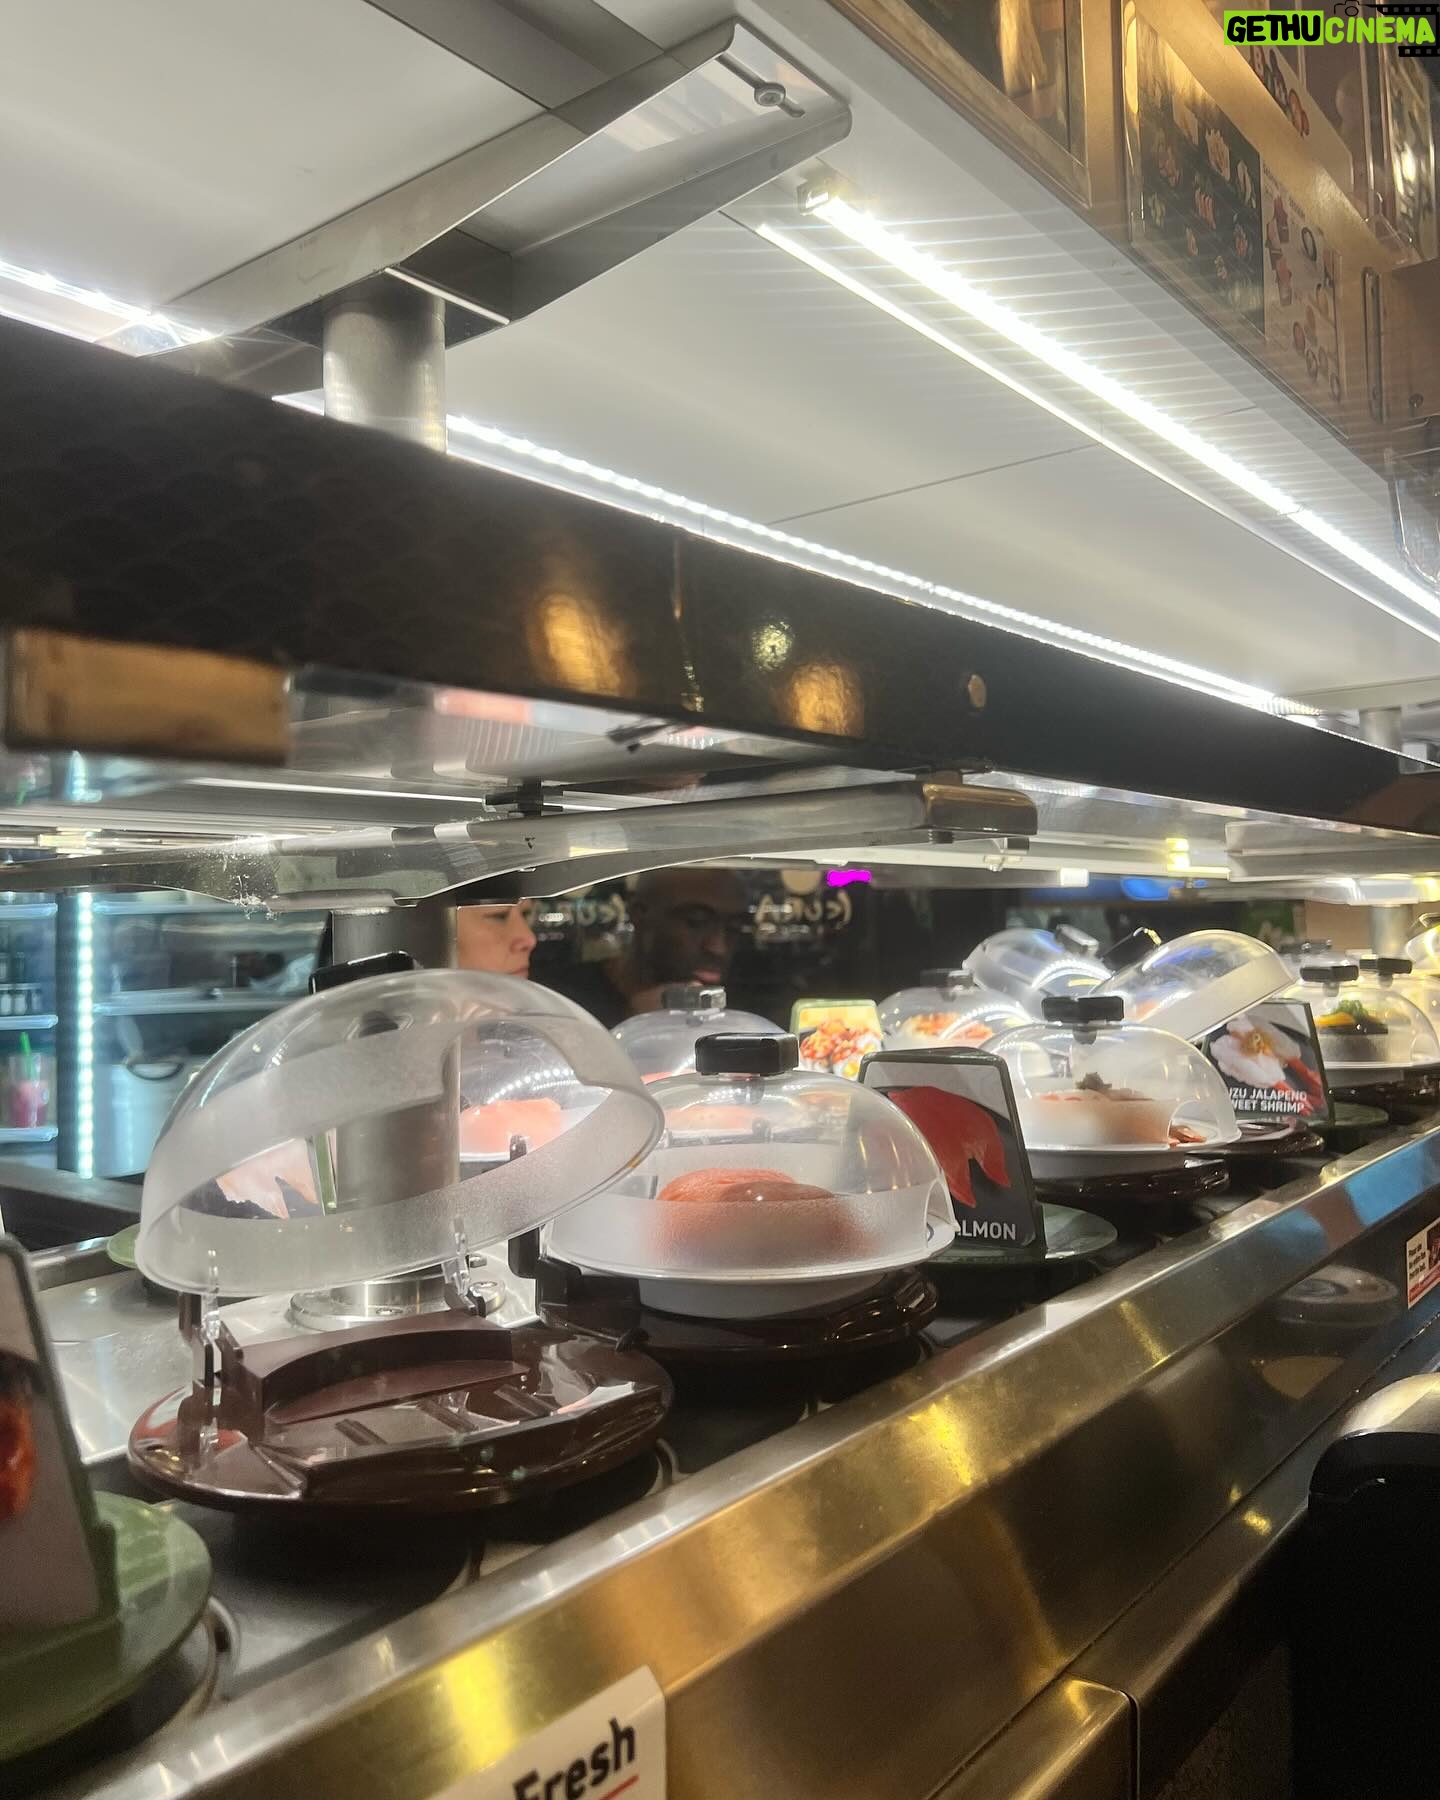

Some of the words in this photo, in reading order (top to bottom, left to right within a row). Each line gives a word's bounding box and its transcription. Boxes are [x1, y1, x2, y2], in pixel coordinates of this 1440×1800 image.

[1260, 1101, 1304, 1113] SHRIMP
[958, 1219, 1016, 1240] LMON
[512, 1717, 636, 1800] Fresh
